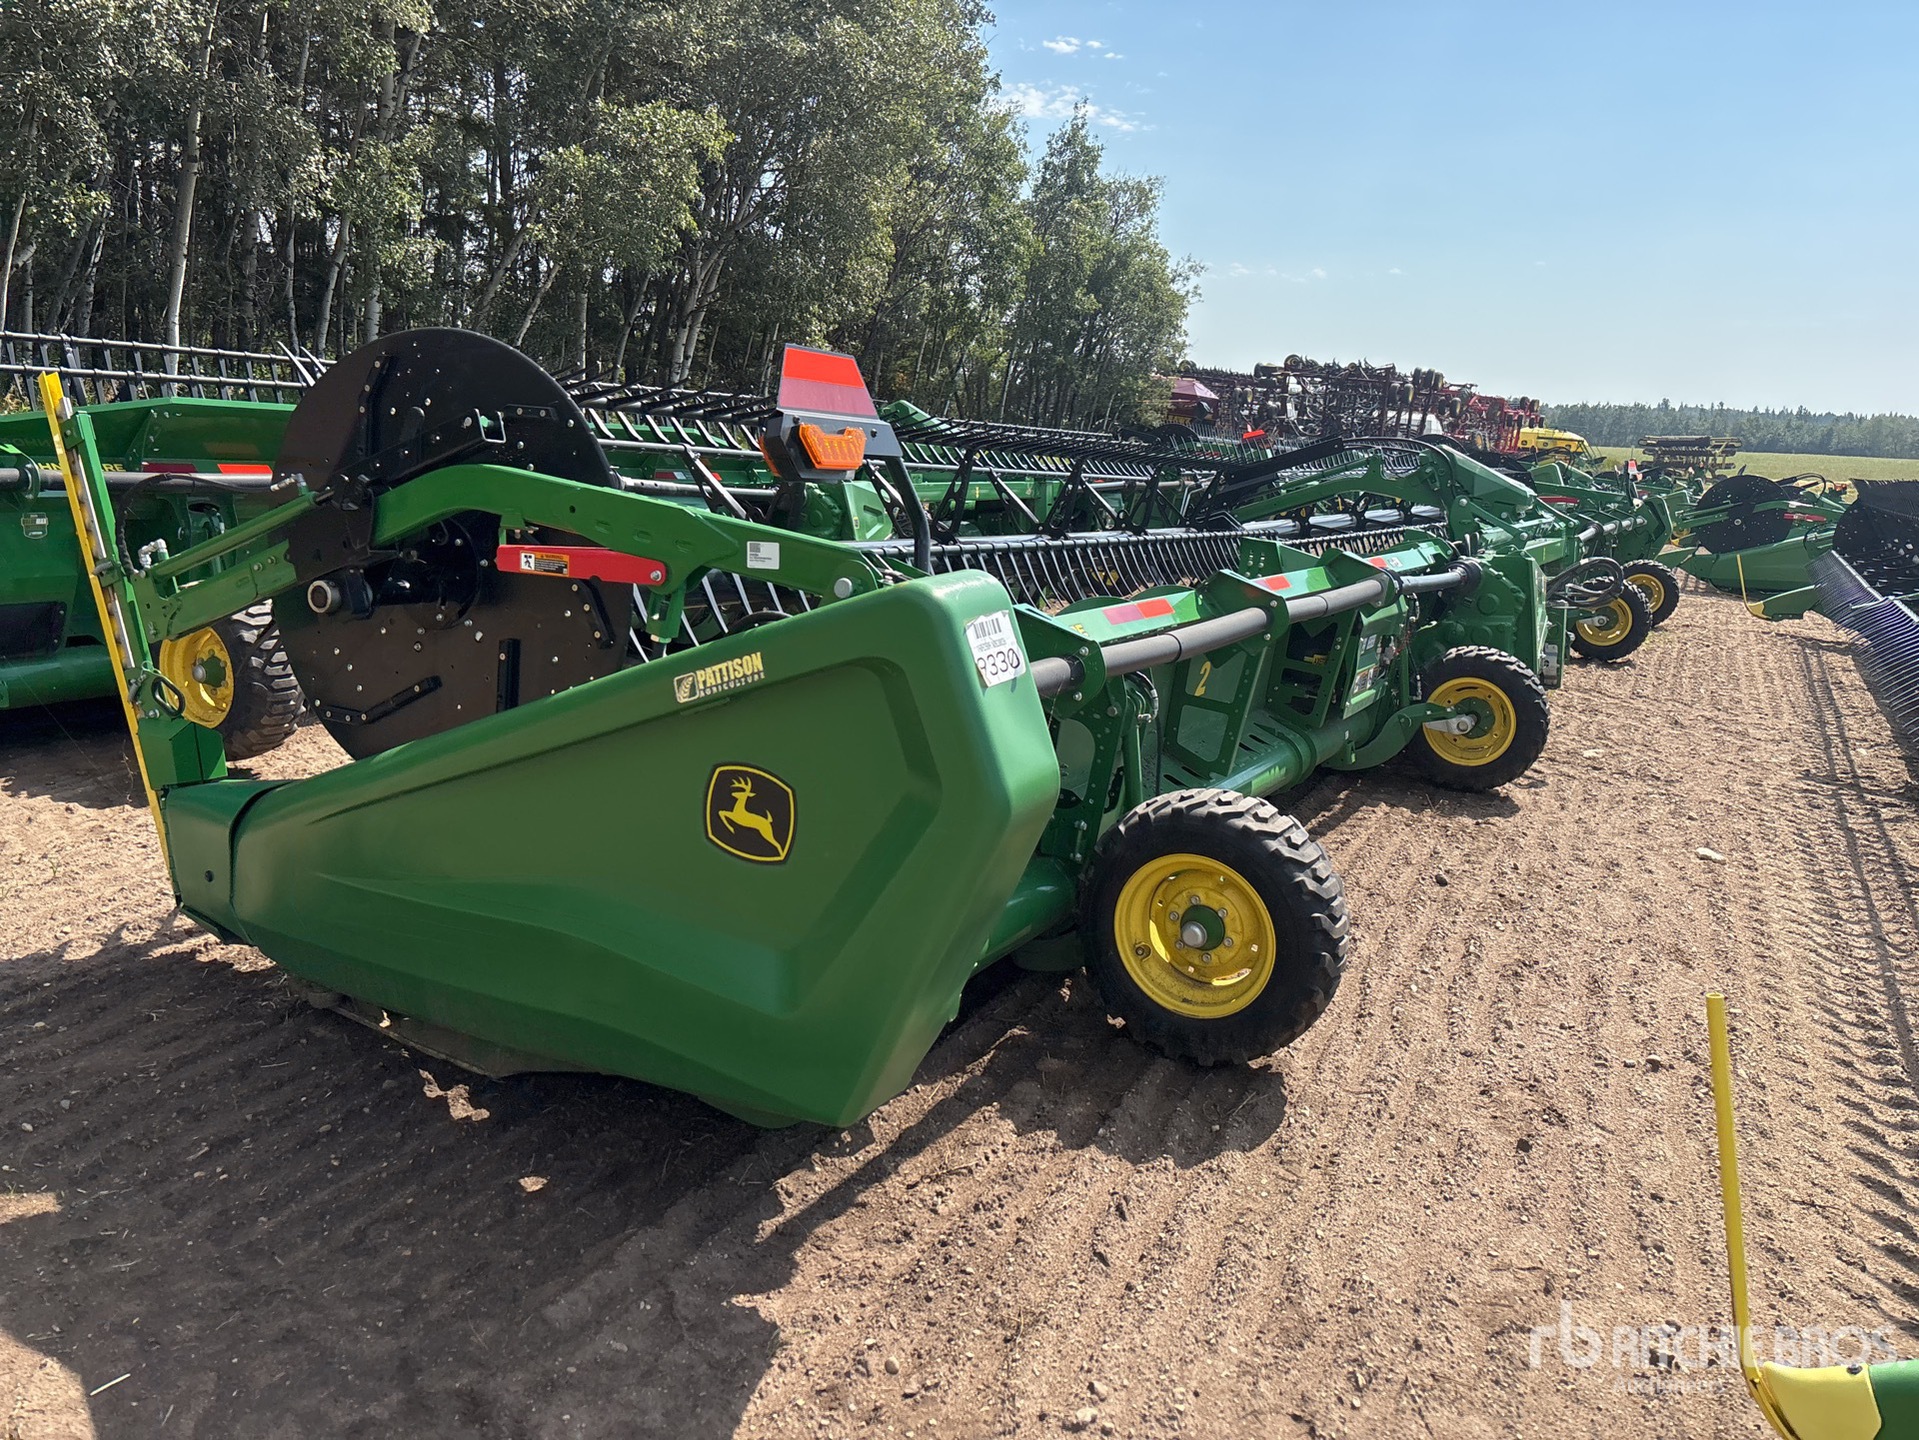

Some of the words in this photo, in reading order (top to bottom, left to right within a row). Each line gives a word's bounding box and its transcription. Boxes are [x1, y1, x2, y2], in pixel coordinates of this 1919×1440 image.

[696, 651, 763, 690] PATTISON
[977, 647, 1020, 678] 9330
[699, 672, 765, 697] AGRICULTURE
